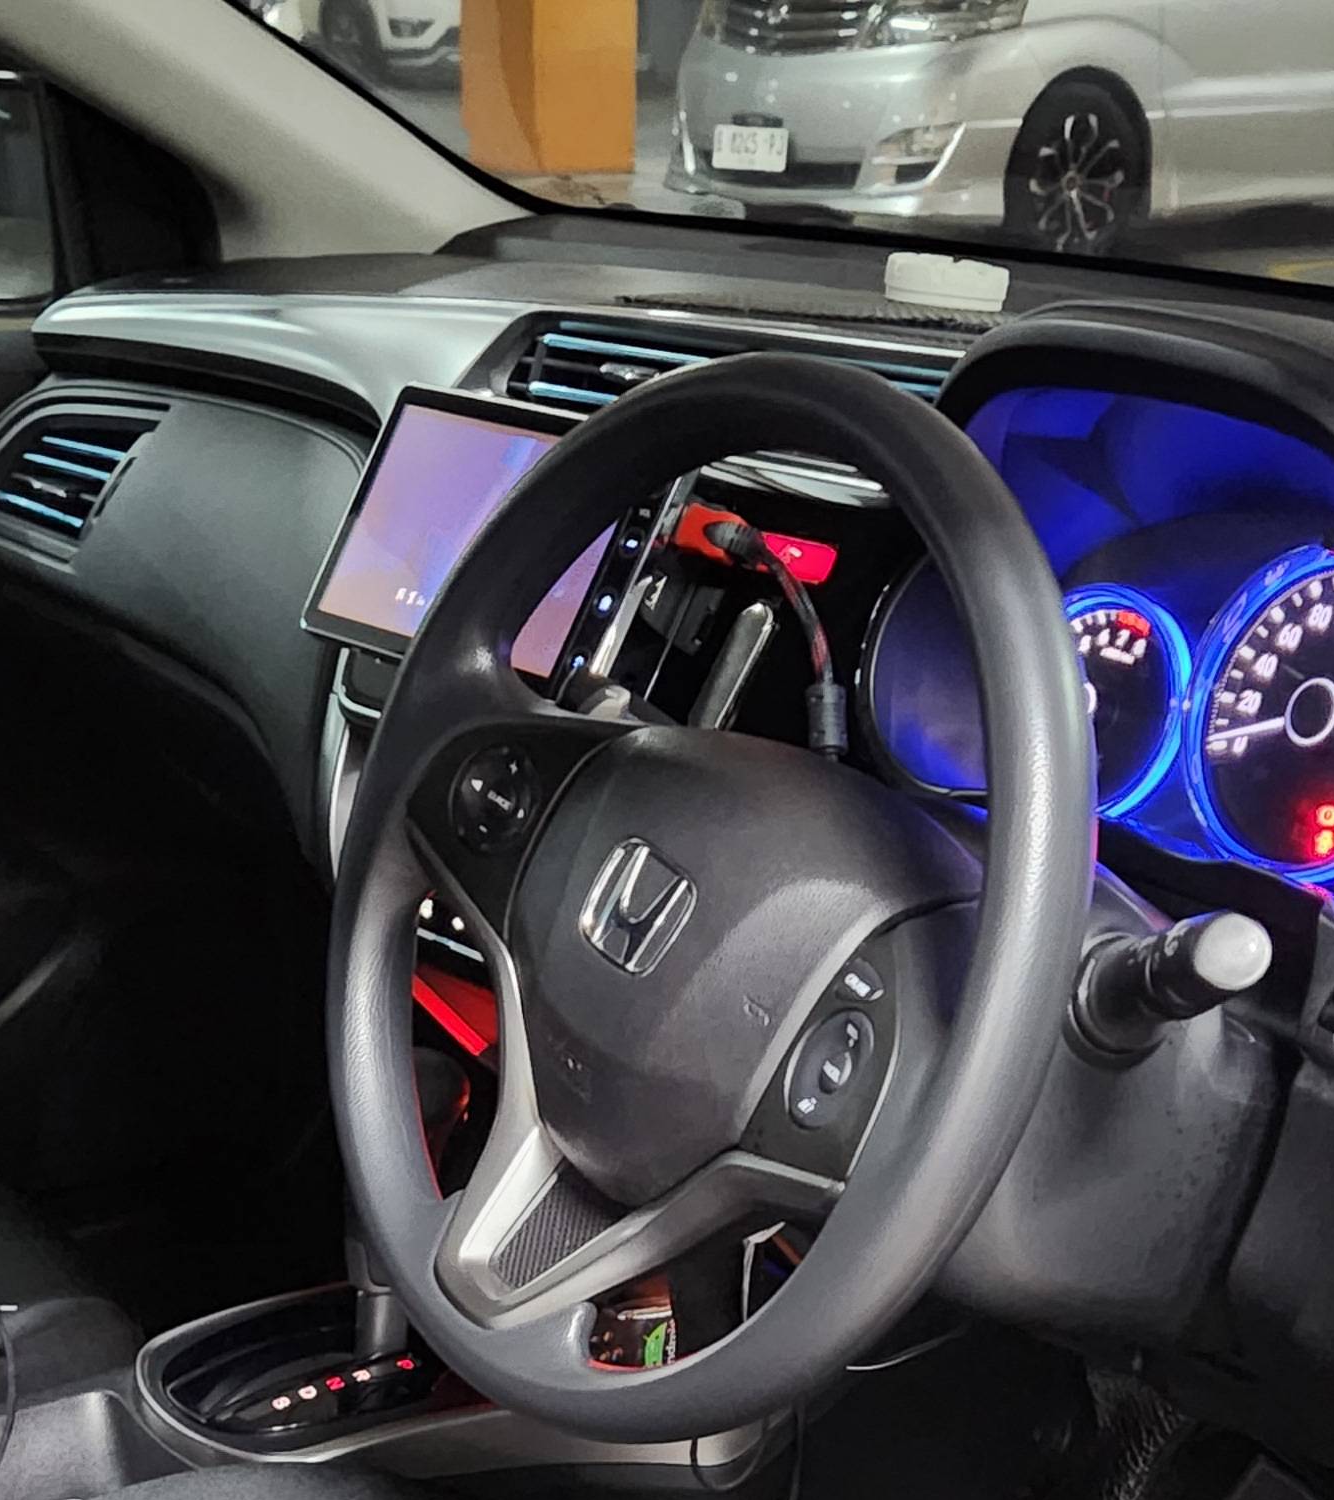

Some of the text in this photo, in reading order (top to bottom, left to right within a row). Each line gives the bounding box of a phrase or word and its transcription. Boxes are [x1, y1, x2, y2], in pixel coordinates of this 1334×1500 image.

[1307, 603, 1333, 632] 80
[1276, 623, 1303, 651] 60
[1253, 652, 1279, 680] 40
[1236, 689, 1262, 715] 20
[326, 1376, 346, 1391] N
[352, 1368, 372, 1383] R
